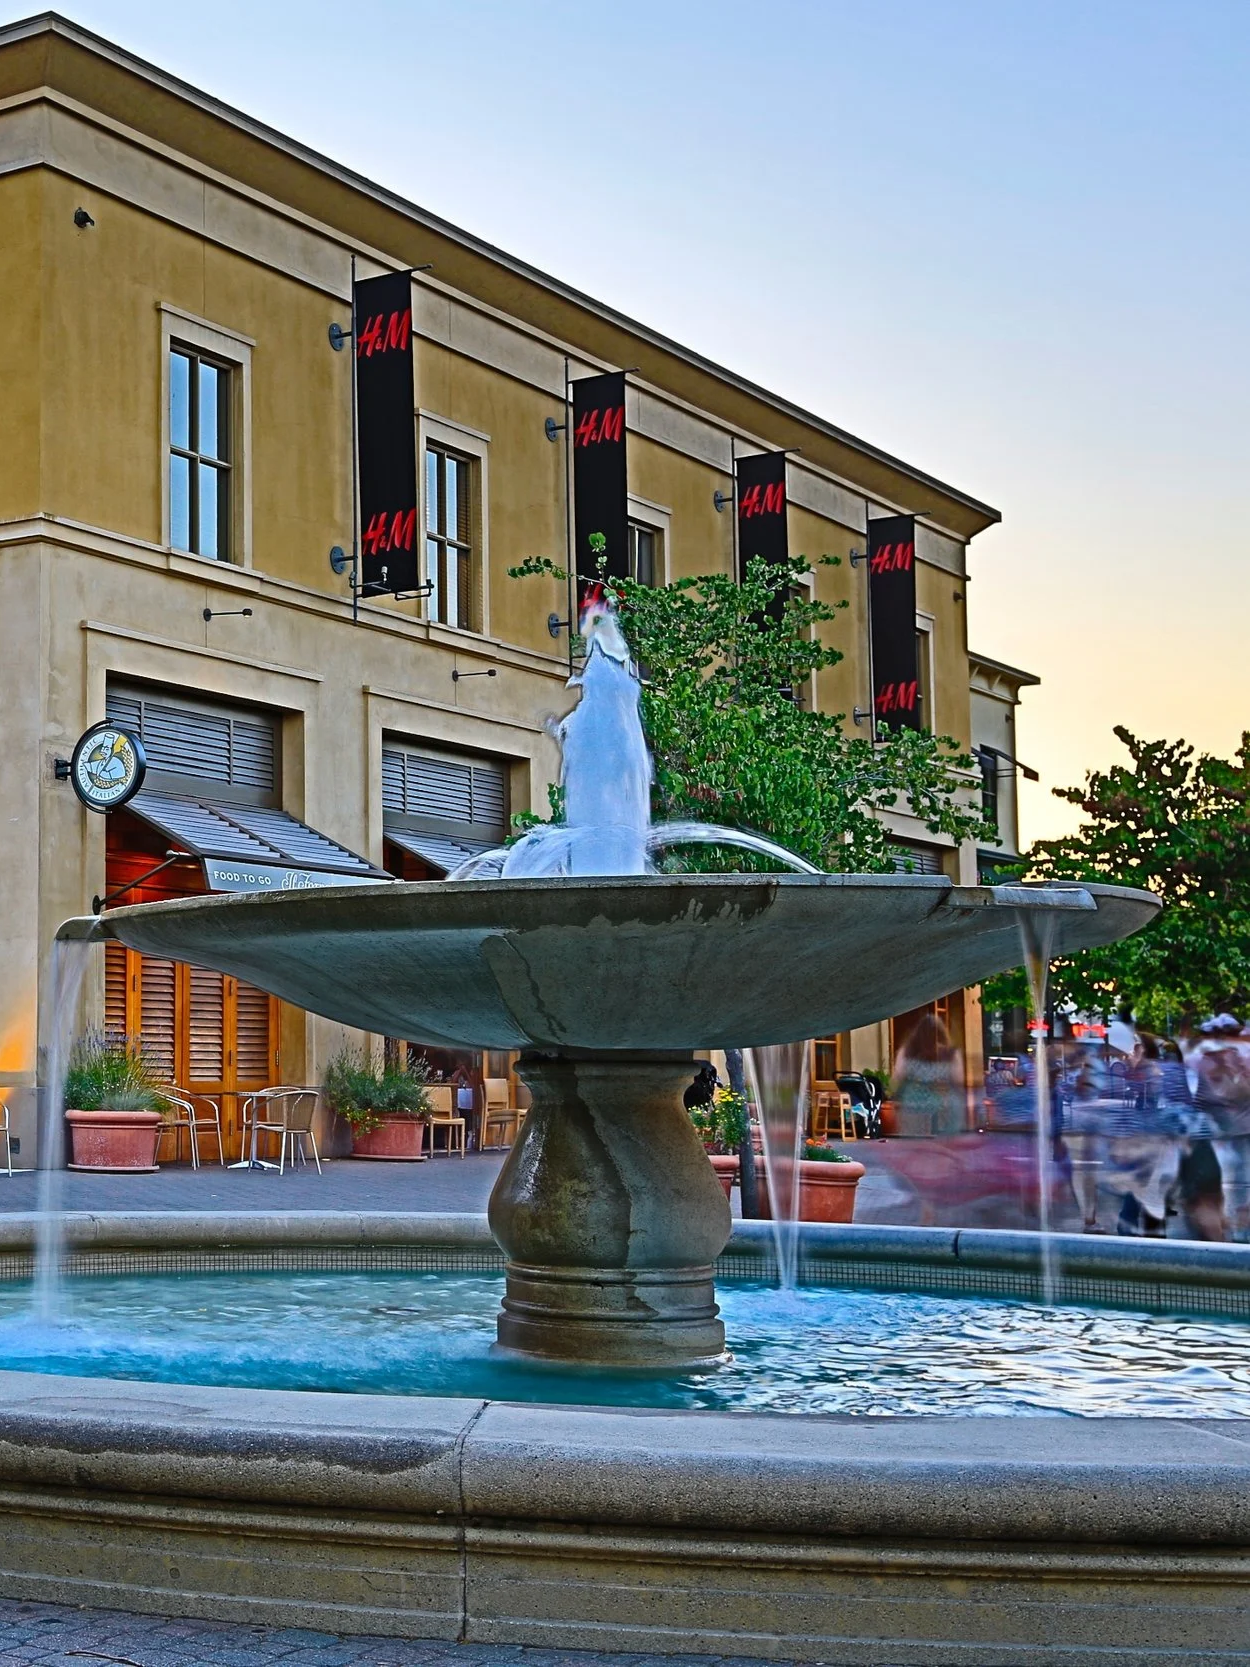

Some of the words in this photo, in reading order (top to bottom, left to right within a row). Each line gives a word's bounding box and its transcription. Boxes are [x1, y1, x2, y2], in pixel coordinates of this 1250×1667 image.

[357, 308, 411, 358] H&M
[575, 405, 624, 447] H&M
[740, 481, 784, 518] H&M
[362, 508, 417, 556] H&M
[870, 542, 913, 574] H&M
[876, 680, 917, 714] H&M
[91, 788, 121, 799] ITALIAN
[213, 870, 241, 883] FOOD
[243, 873, 256, 884] TO
[257, 875, 272, 886] GO
